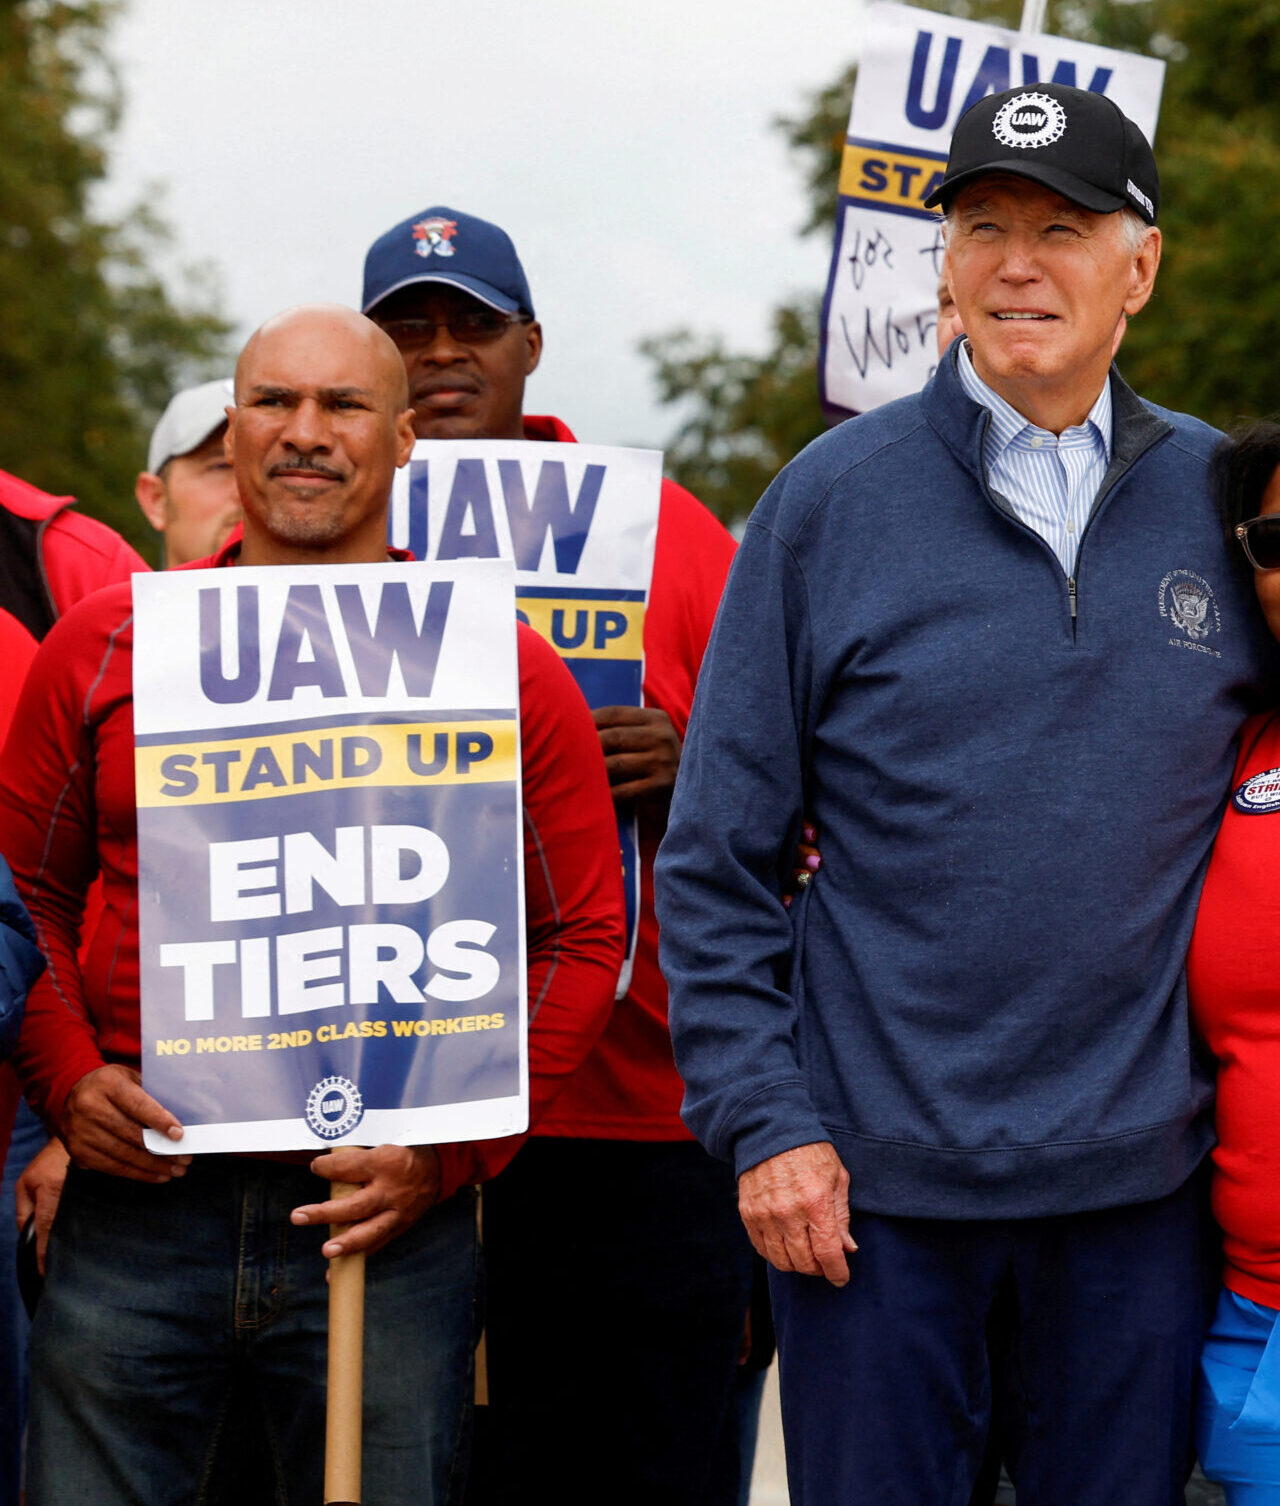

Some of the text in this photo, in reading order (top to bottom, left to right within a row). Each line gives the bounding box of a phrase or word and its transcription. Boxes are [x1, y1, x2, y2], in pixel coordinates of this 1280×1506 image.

[1011, 111, 1048, 127] UAW
[387, 458, 607, 575] UAW
[199, 580, 455, 705] UAW
[551, 608, 628, 650] UP
[159, 730, 494, 798] STAND UP
[208, 825, 450, 922] END
[160, 919, 500, 1022] TIERS
[155, 1012, 505, 1056] NO MORE 2ND CLASS WORKERS
[322, 1098, 345, 1114] UAW
